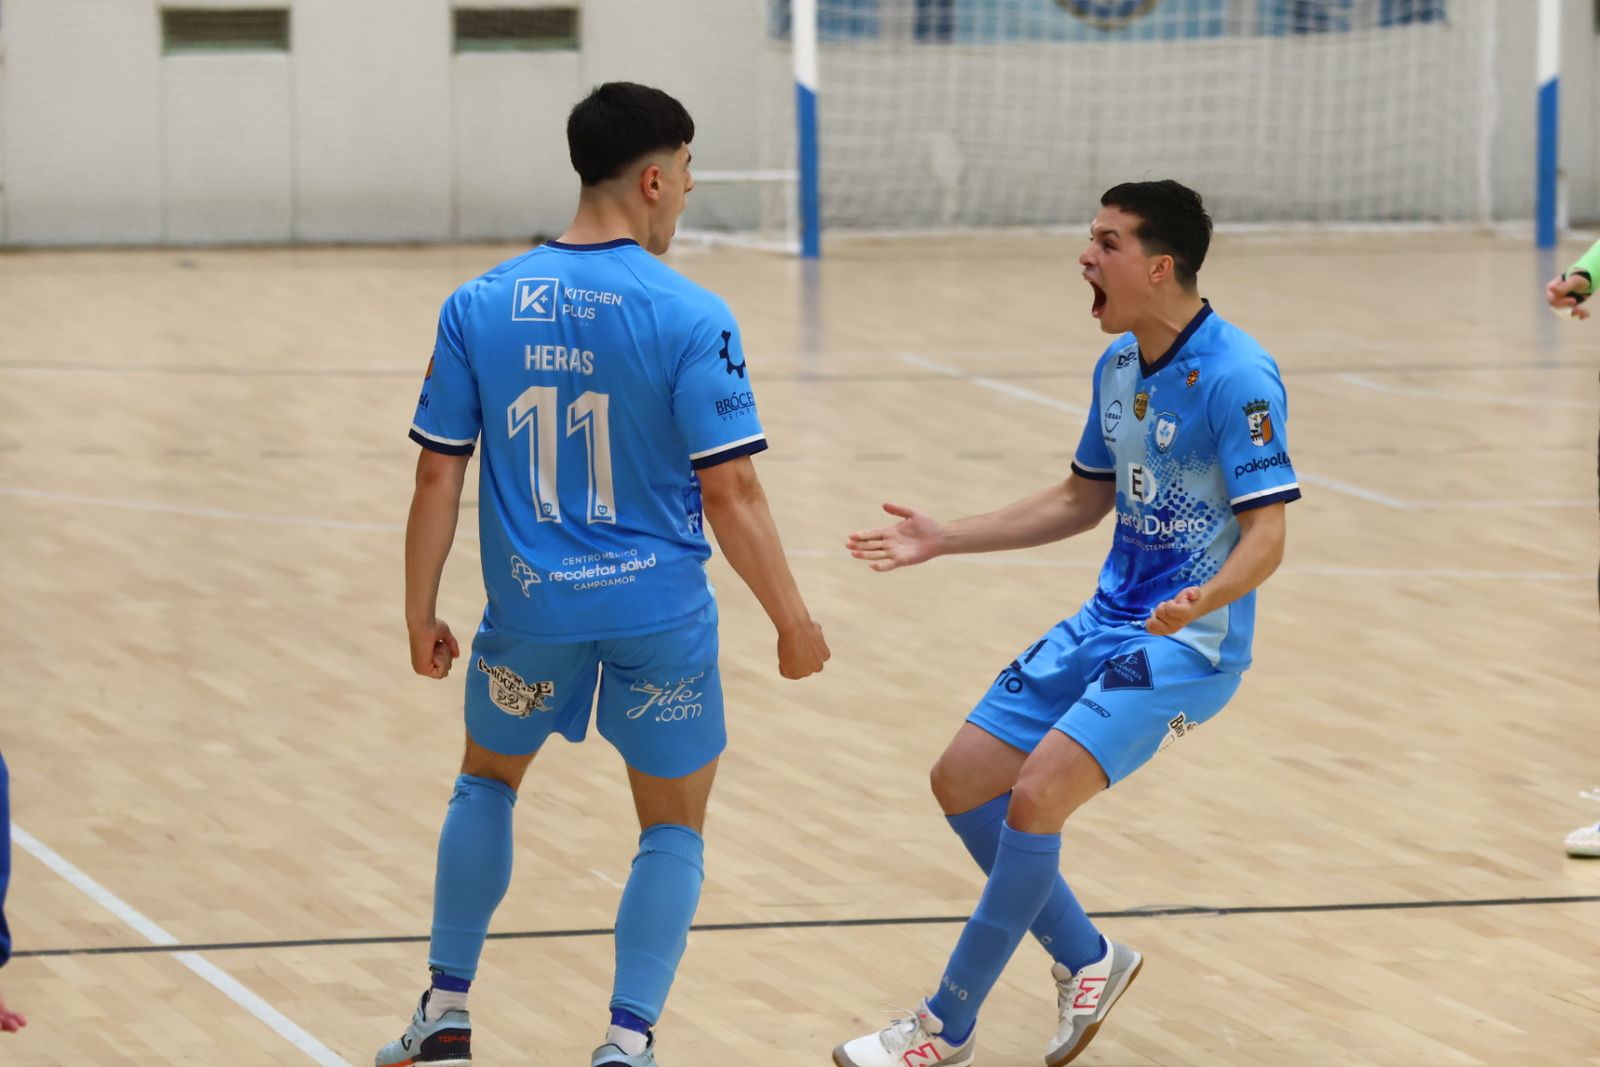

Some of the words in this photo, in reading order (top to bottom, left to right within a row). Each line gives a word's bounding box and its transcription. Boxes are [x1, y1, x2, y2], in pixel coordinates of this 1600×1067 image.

[563, 287, 622, 306] KITCHEN
[562, 304, 596, 319] PLUS
[524, 344, 594, 376] HERAS
[507, 385, 616, 525] 11
[549, 564, 616, 582] recoletas
[620, 553, 656, 573] salud
[562, 553, 600, 566] CENTRO
[573, 575, 636, 591] CAMPOAMOR
[655, 703, 703, 722] .com
